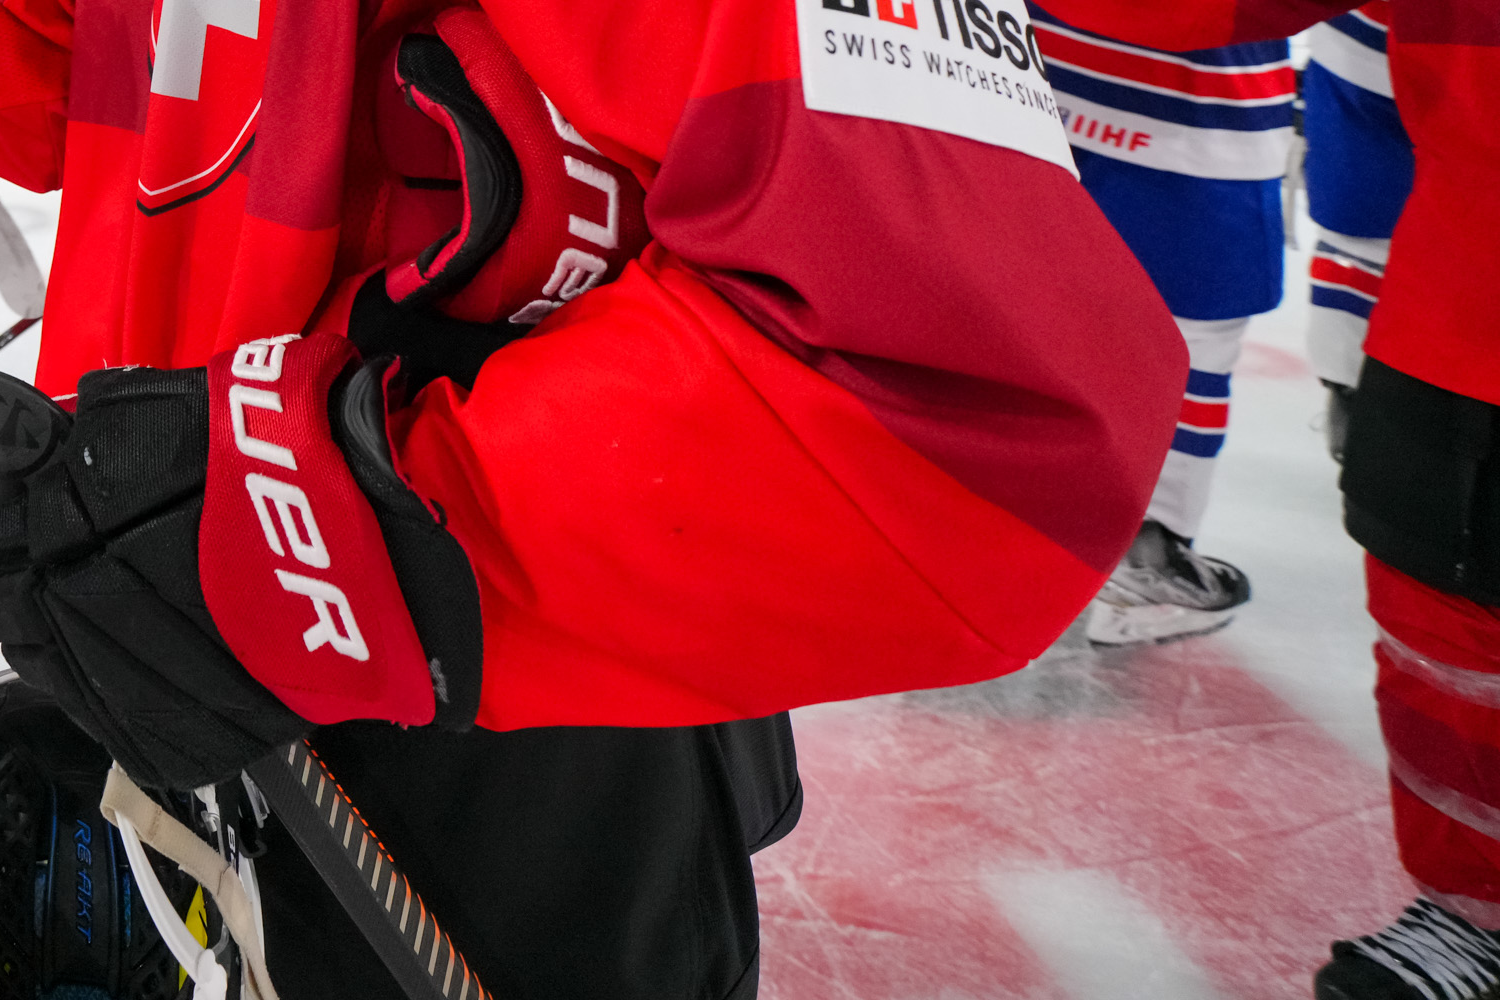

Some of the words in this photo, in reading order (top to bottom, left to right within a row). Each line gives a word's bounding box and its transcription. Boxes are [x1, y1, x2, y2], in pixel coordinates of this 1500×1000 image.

[825, 29, 911, 68] SWISS
[923, 50, 1012, 99] WATCHES
[1072, 114, 1152, 152] IIHF
